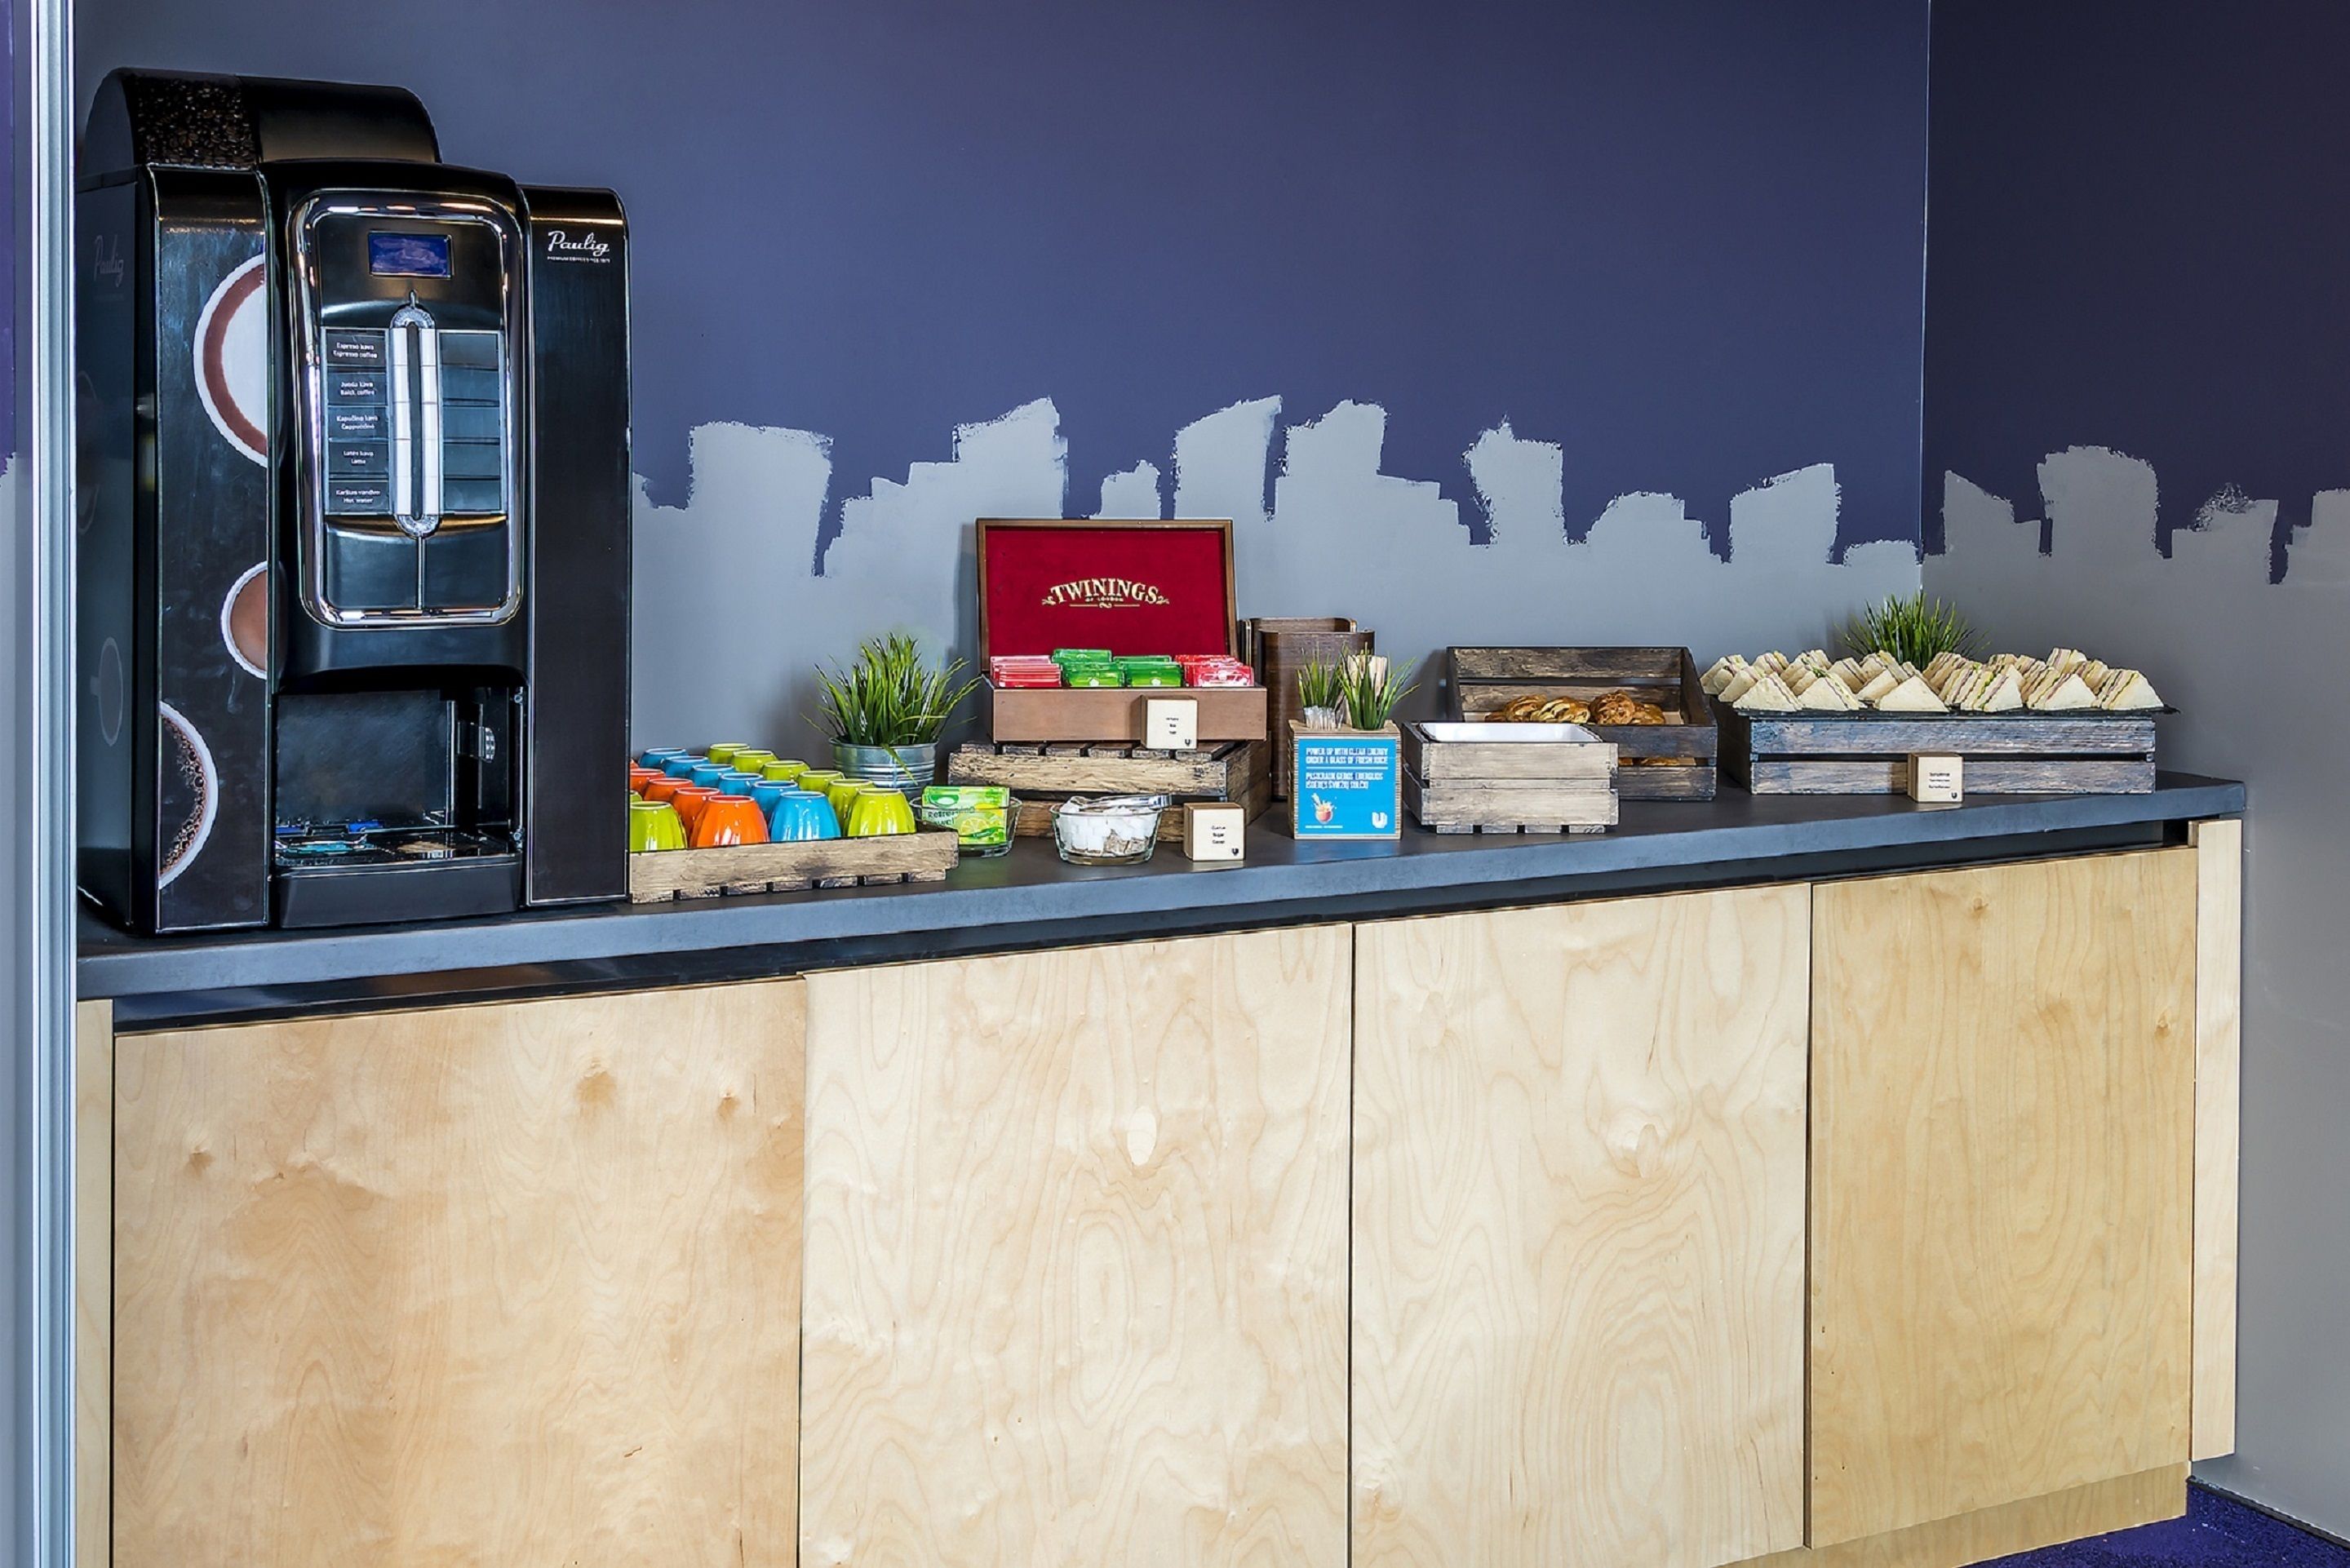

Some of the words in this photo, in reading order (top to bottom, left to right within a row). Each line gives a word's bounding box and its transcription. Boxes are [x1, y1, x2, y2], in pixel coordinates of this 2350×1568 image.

[548, 230, 610, 257] Paulig
[93, 233, 124, 287] Paulig
[1050, 578, 1159, 604] TWININGS
[1306, 747, 1325, 755] POWER
[1326, 747, 1335, 755] UP
[1335, 747, 1349, 755] WITH
[1306, 755, 1324, 764] ORDER
[1330, 755, 1346, 764] GLASS
[1347, 755, 1354, 764] OF
